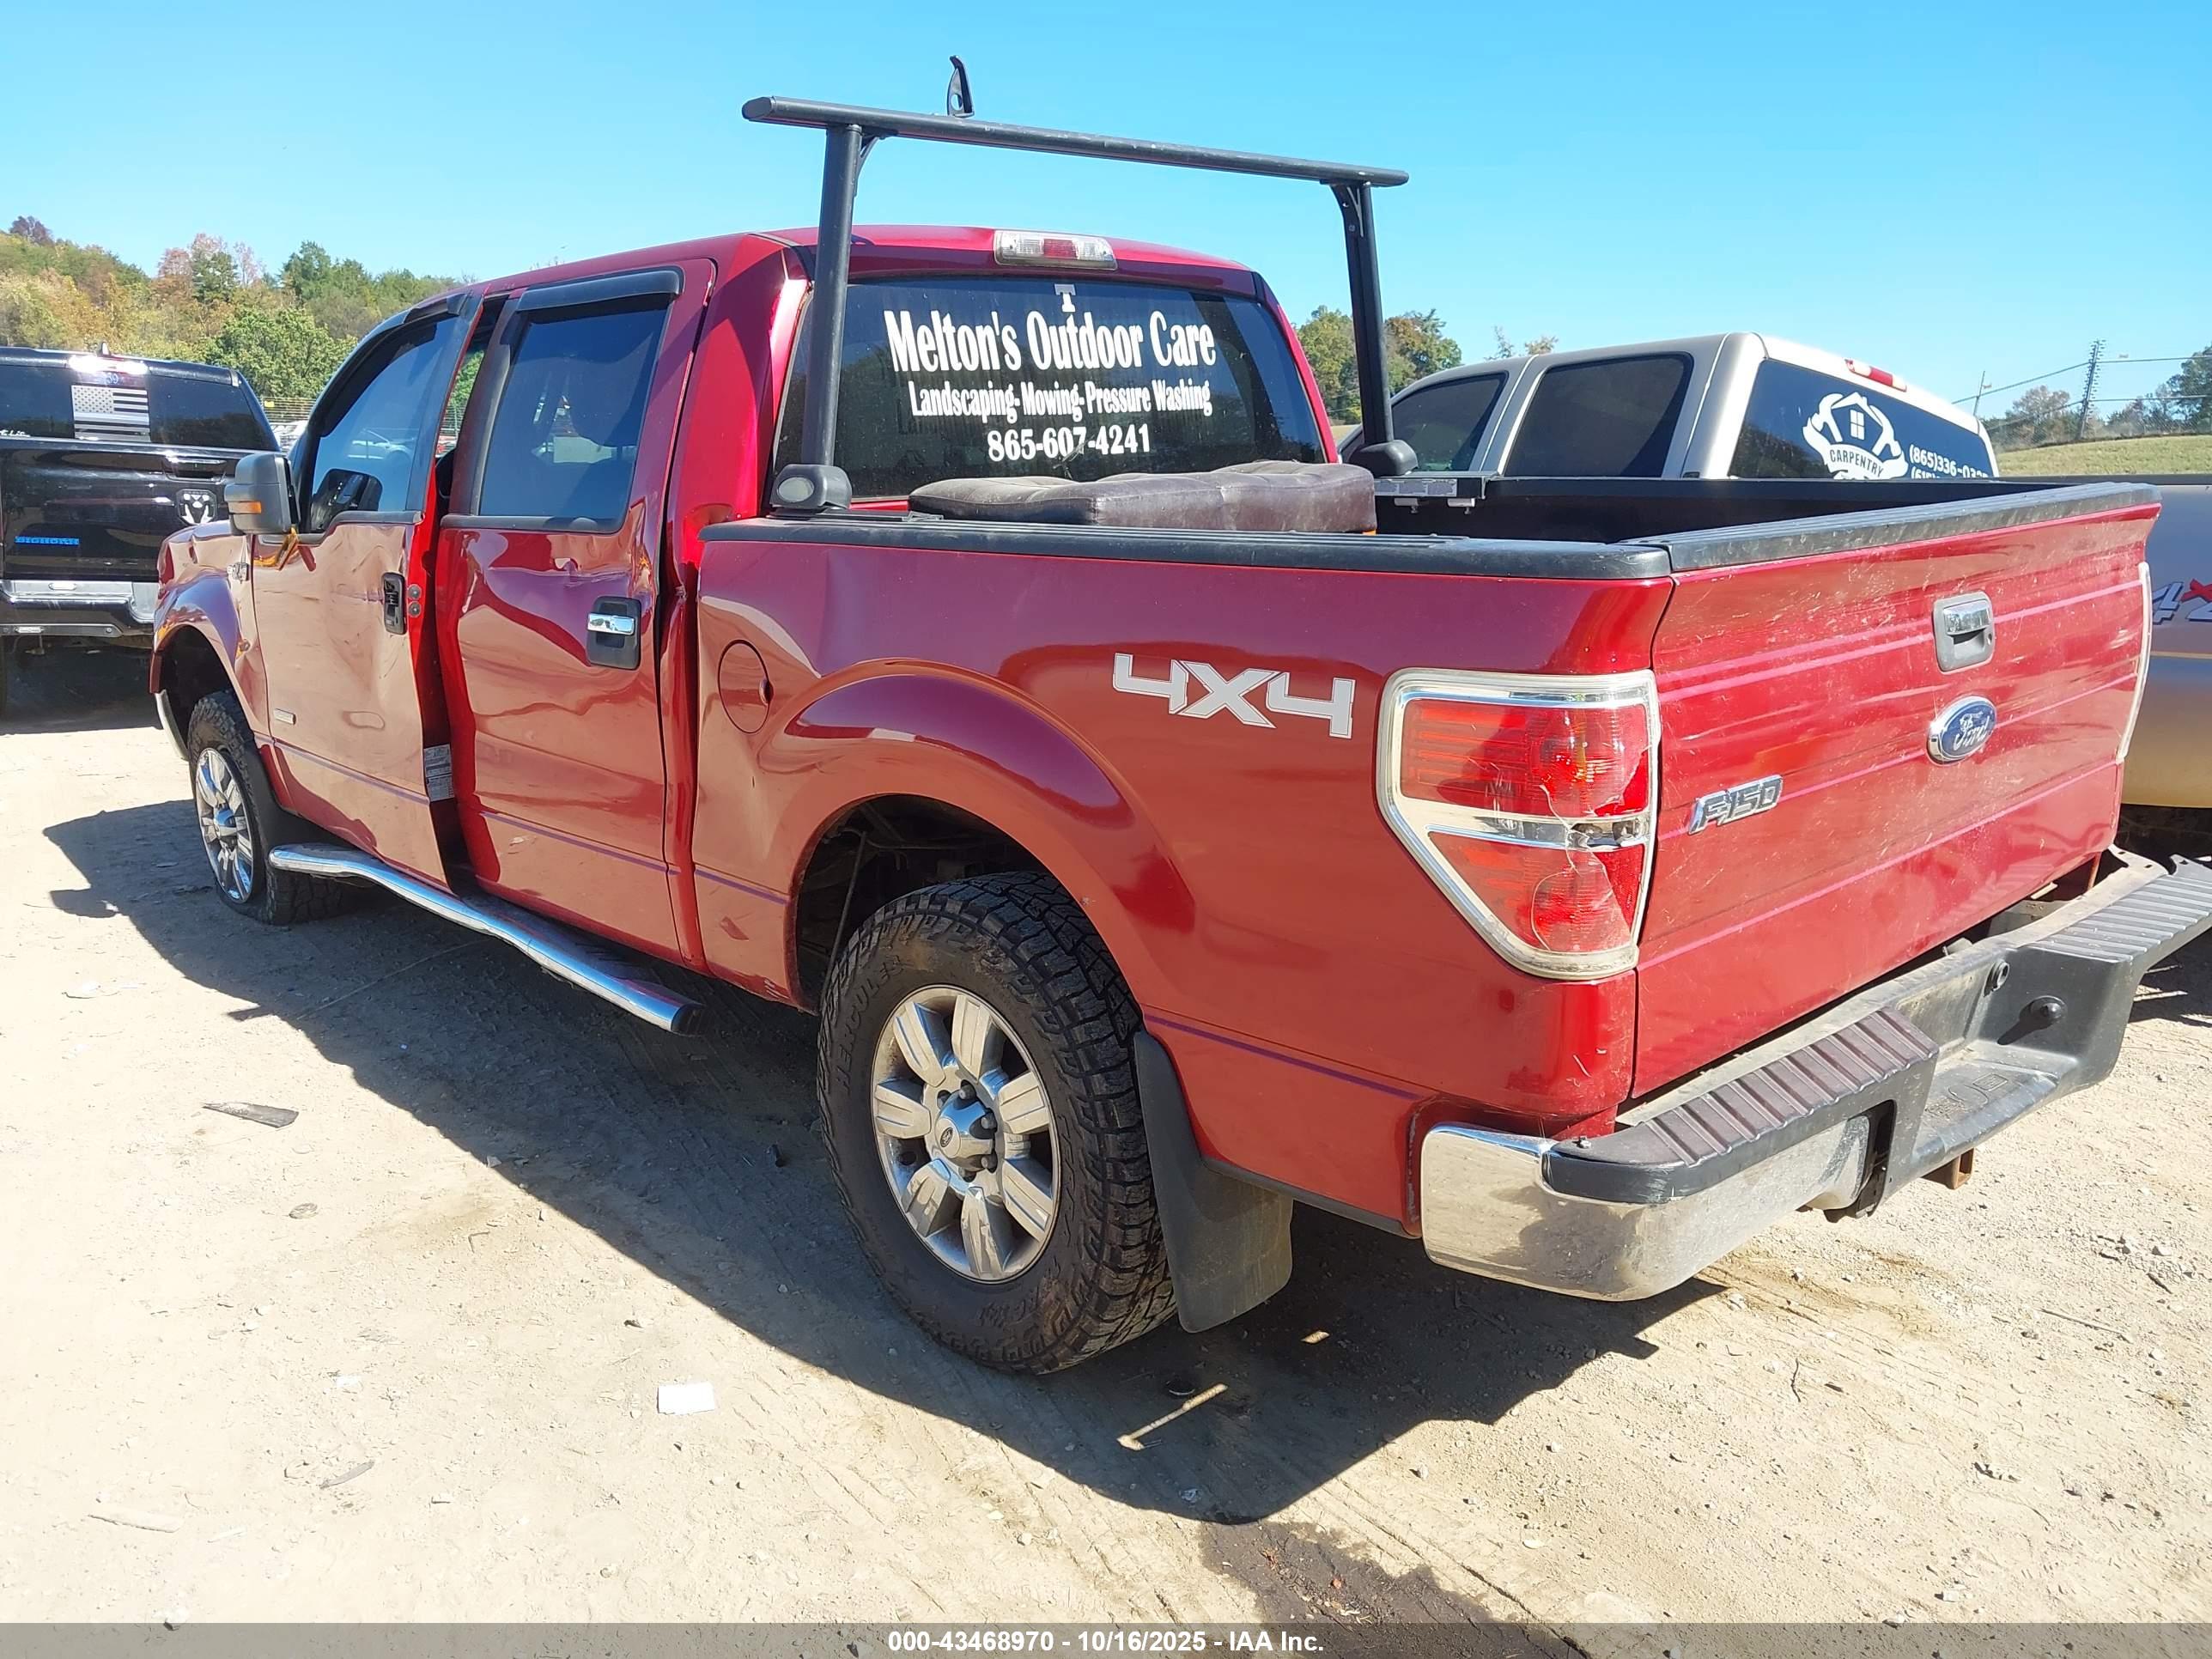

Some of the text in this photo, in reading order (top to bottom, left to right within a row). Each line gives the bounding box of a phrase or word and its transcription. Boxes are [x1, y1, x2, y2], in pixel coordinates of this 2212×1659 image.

[883, 310, 1217, 373] Melton's Outdoor Care
[1085, 380, 1152, 415] Pressure
[1152, 378, 1213, 417] Washing
[988, 422, 1151, 462] 865-607-4241
[1829, 449, 1884, 478] CARPENTRY
[1113, 653, 1356, 739] 4X4
[1953, 711, 1990, 750] Ford
